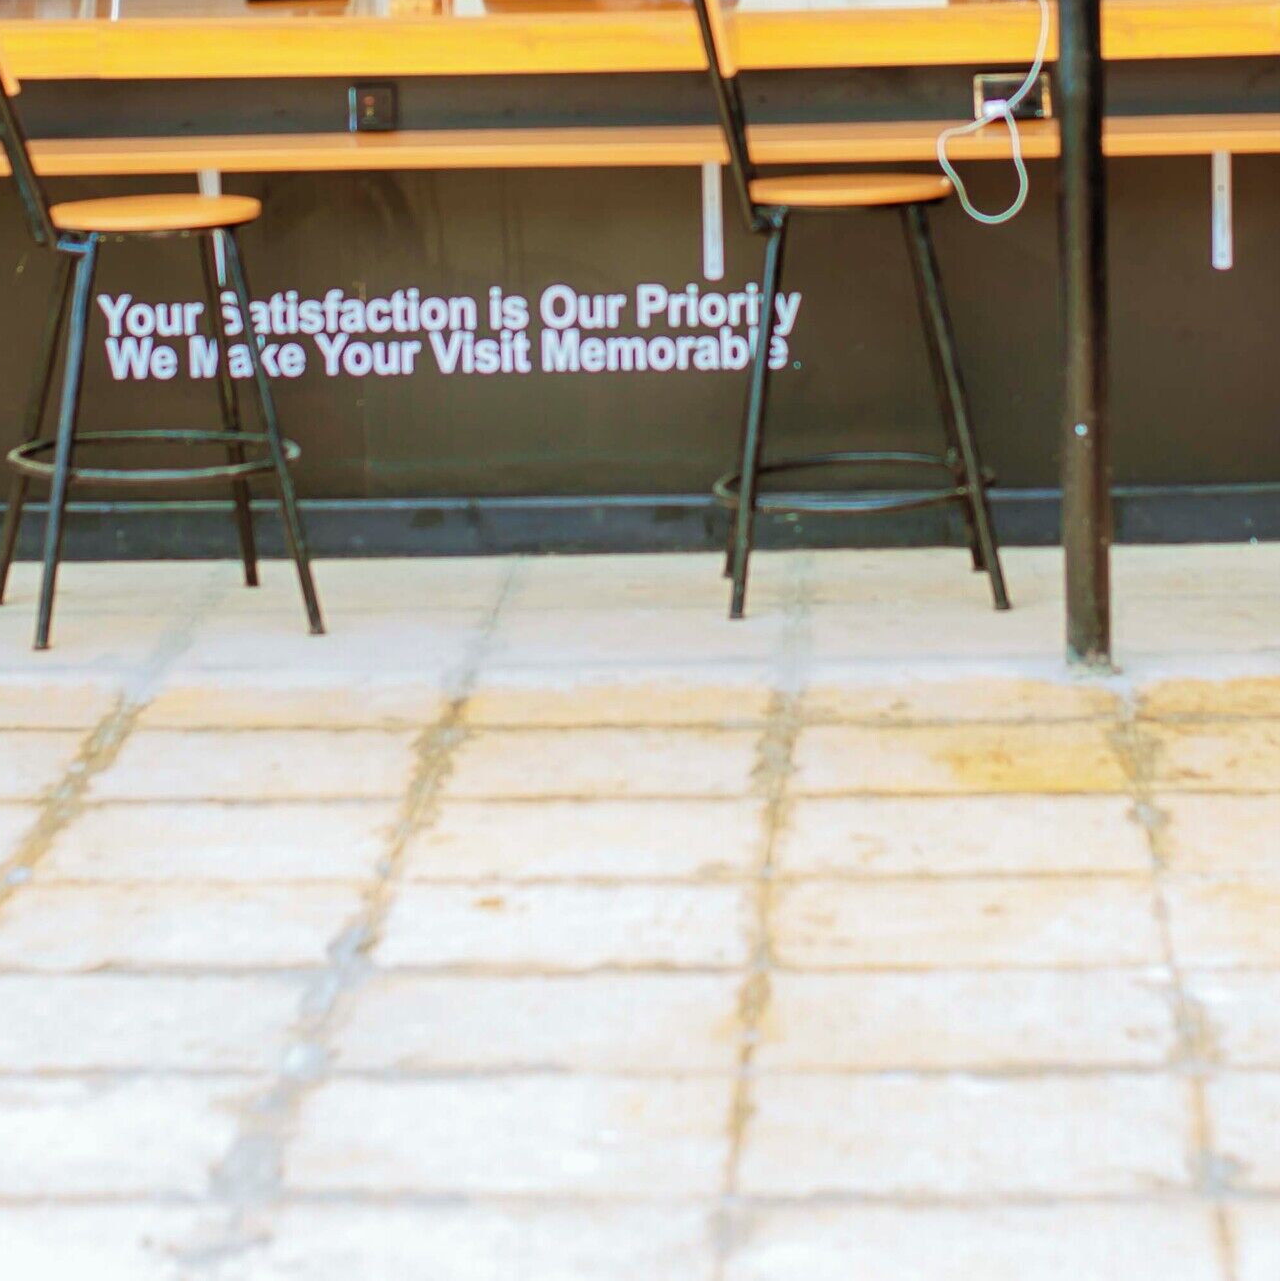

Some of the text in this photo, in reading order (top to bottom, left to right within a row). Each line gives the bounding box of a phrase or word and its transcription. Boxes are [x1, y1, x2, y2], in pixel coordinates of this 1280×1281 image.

[96, 281, 802, 338] Your Satisfaction is Our Prioriy
[104, 335, 179, 381] We
[313, 330, 422, 377] Your
[428, 327, 532, 375] Visit
